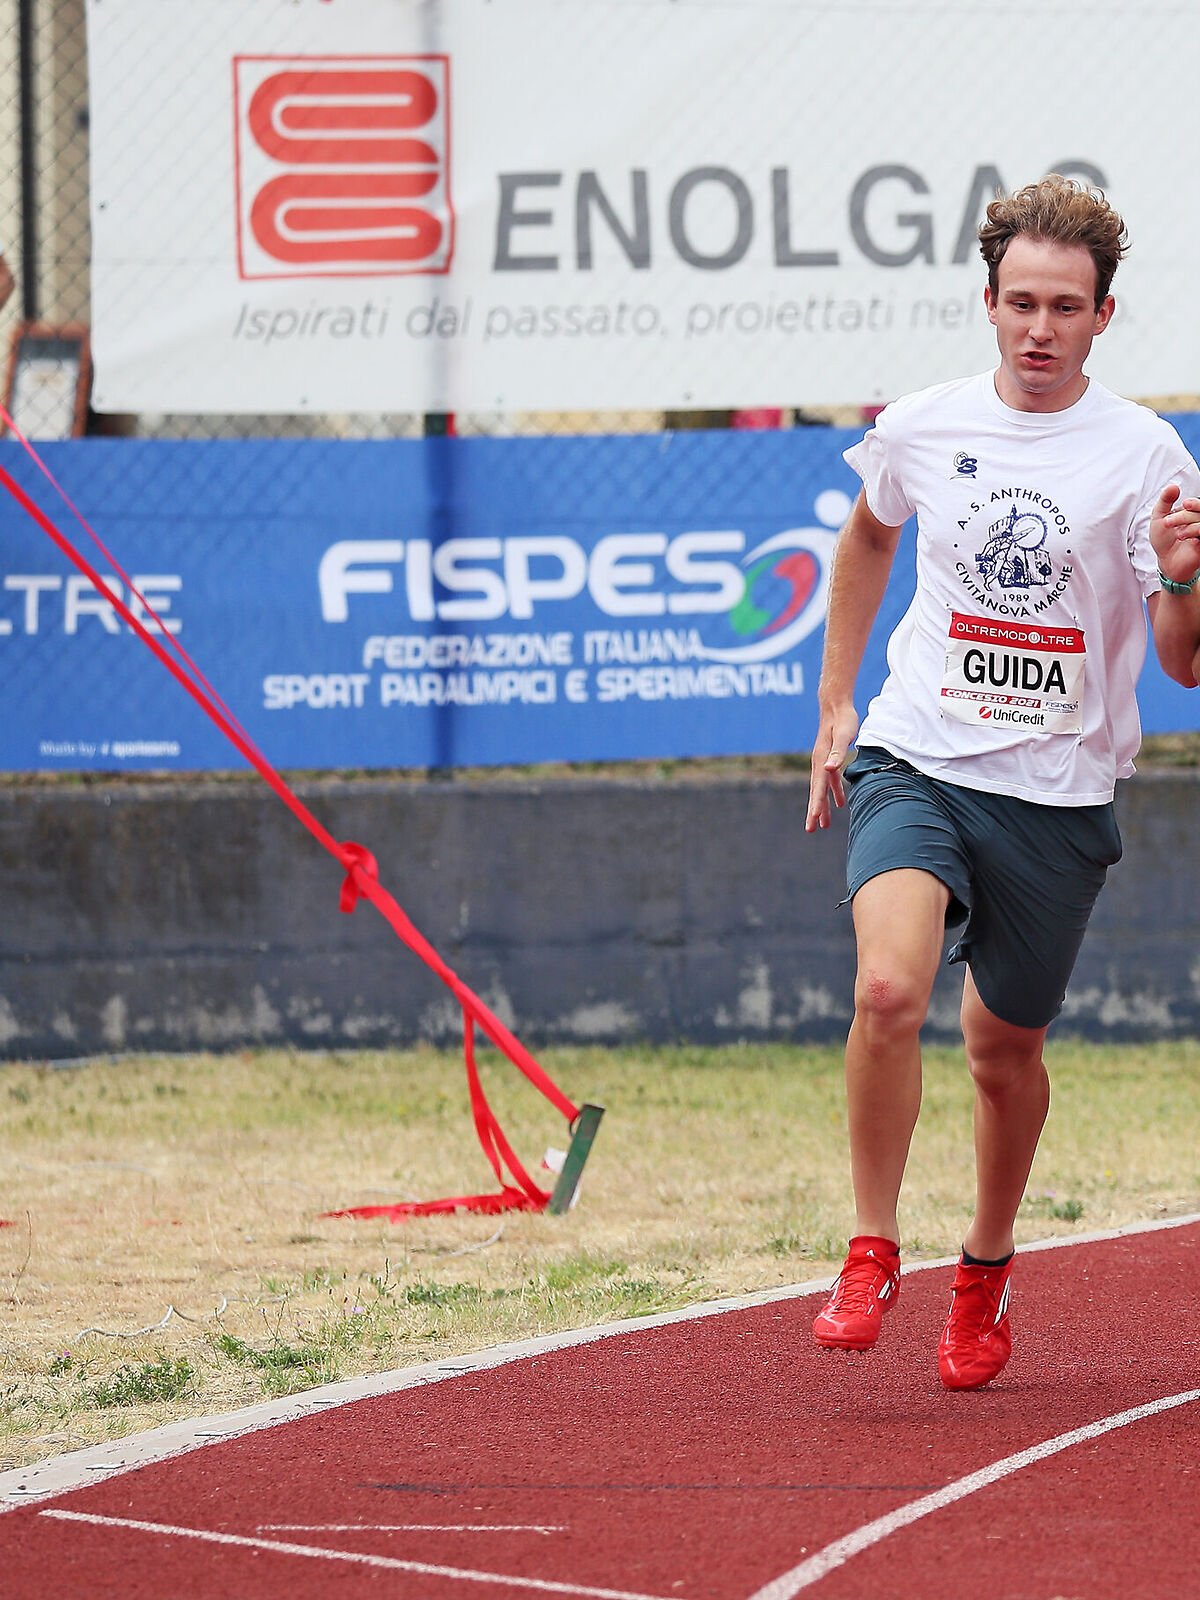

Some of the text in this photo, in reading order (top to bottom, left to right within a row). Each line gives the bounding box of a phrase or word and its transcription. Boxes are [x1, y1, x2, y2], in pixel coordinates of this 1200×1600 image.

[492, 160, 1112, 273] ENOLGA
[233, 297, 392, 346] Ispirati
[404, 296, 474, 341] dal
[482, 299, 669, 344] passato,
[684, 290, 896, 340] proiettati
[990, 487, 1071, 535] ANTHROPOS
[318, 530, 747, 624] FISPES
[955, 561, 1073, 618] CIVITANOVA MARCHE
[1002, 593, 1030, 603] 1989
[0, 574, 183, 636] TRE
[362, 628, 706, 670] FEDERAZIONE ITALIANA
[956, 622, 1074, 646] OLTREMODOLTRE
[262, 661, 805, 710] SPORT PARALIMPICI E SPERIMENTALI
[963, 648, 1067, 695] GUIDA
[945, 688, 1039, 708] CONCESIO 2021
[993, 708, 1045, 726] UniCredit
